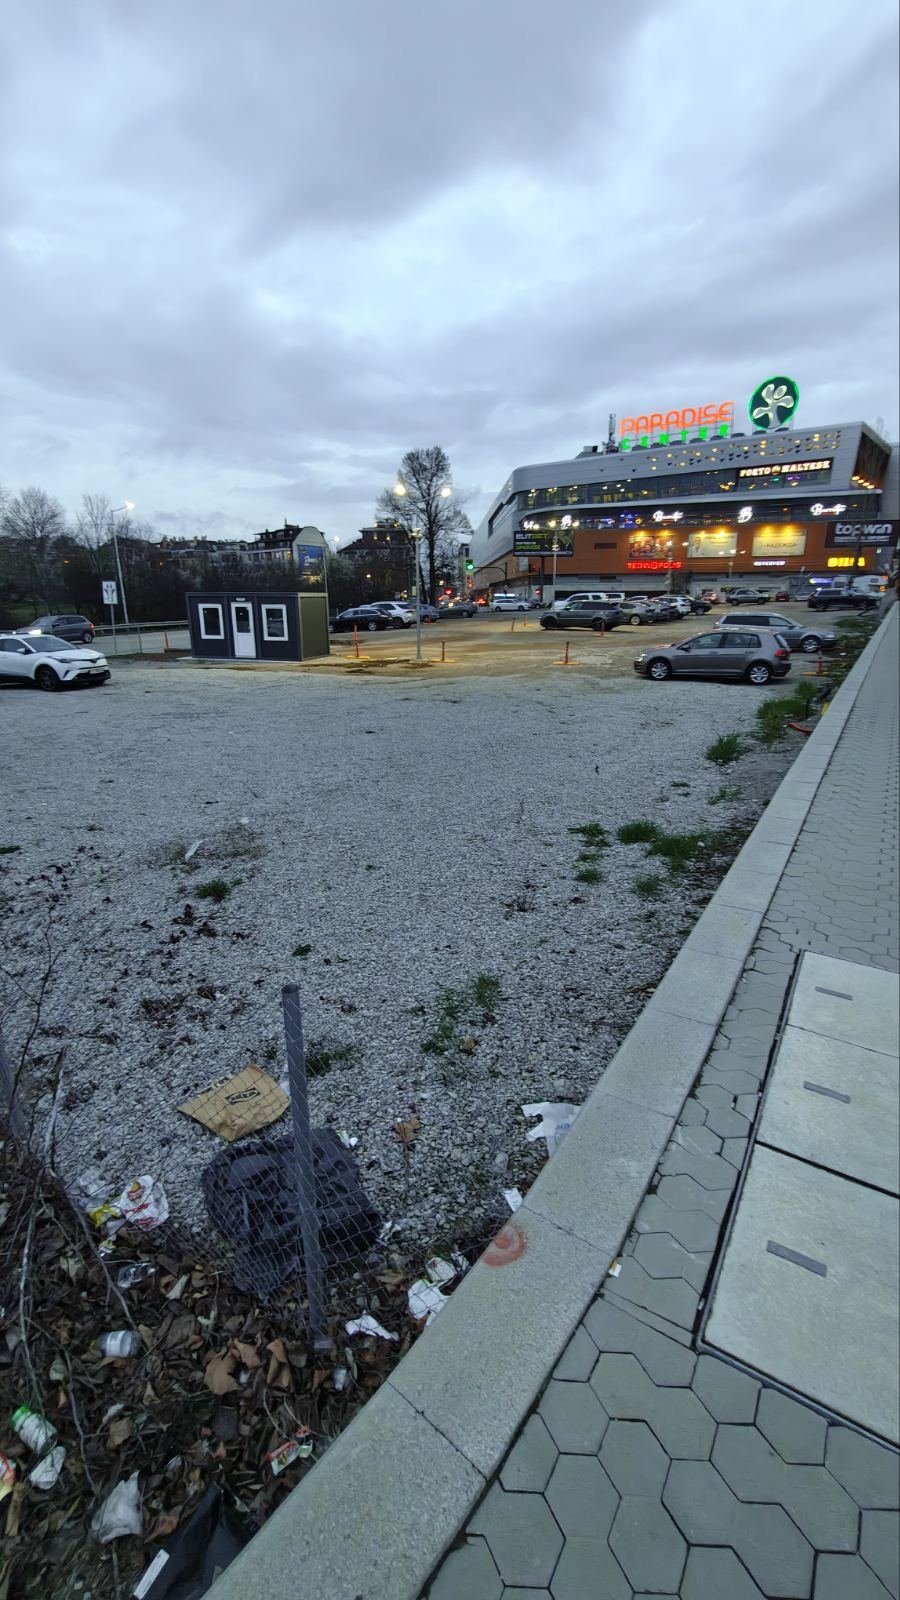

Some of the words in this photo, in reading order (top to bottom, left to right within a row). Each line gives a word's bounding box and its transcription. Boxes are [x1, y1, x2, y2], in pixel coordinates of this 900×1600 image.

[620, 401, 734, 436] PARADISE
[622, 424, 729, 451] CENTER
[739, 466, 771, 477] PORTO
[781, 460, 831, 473] MALTESE
